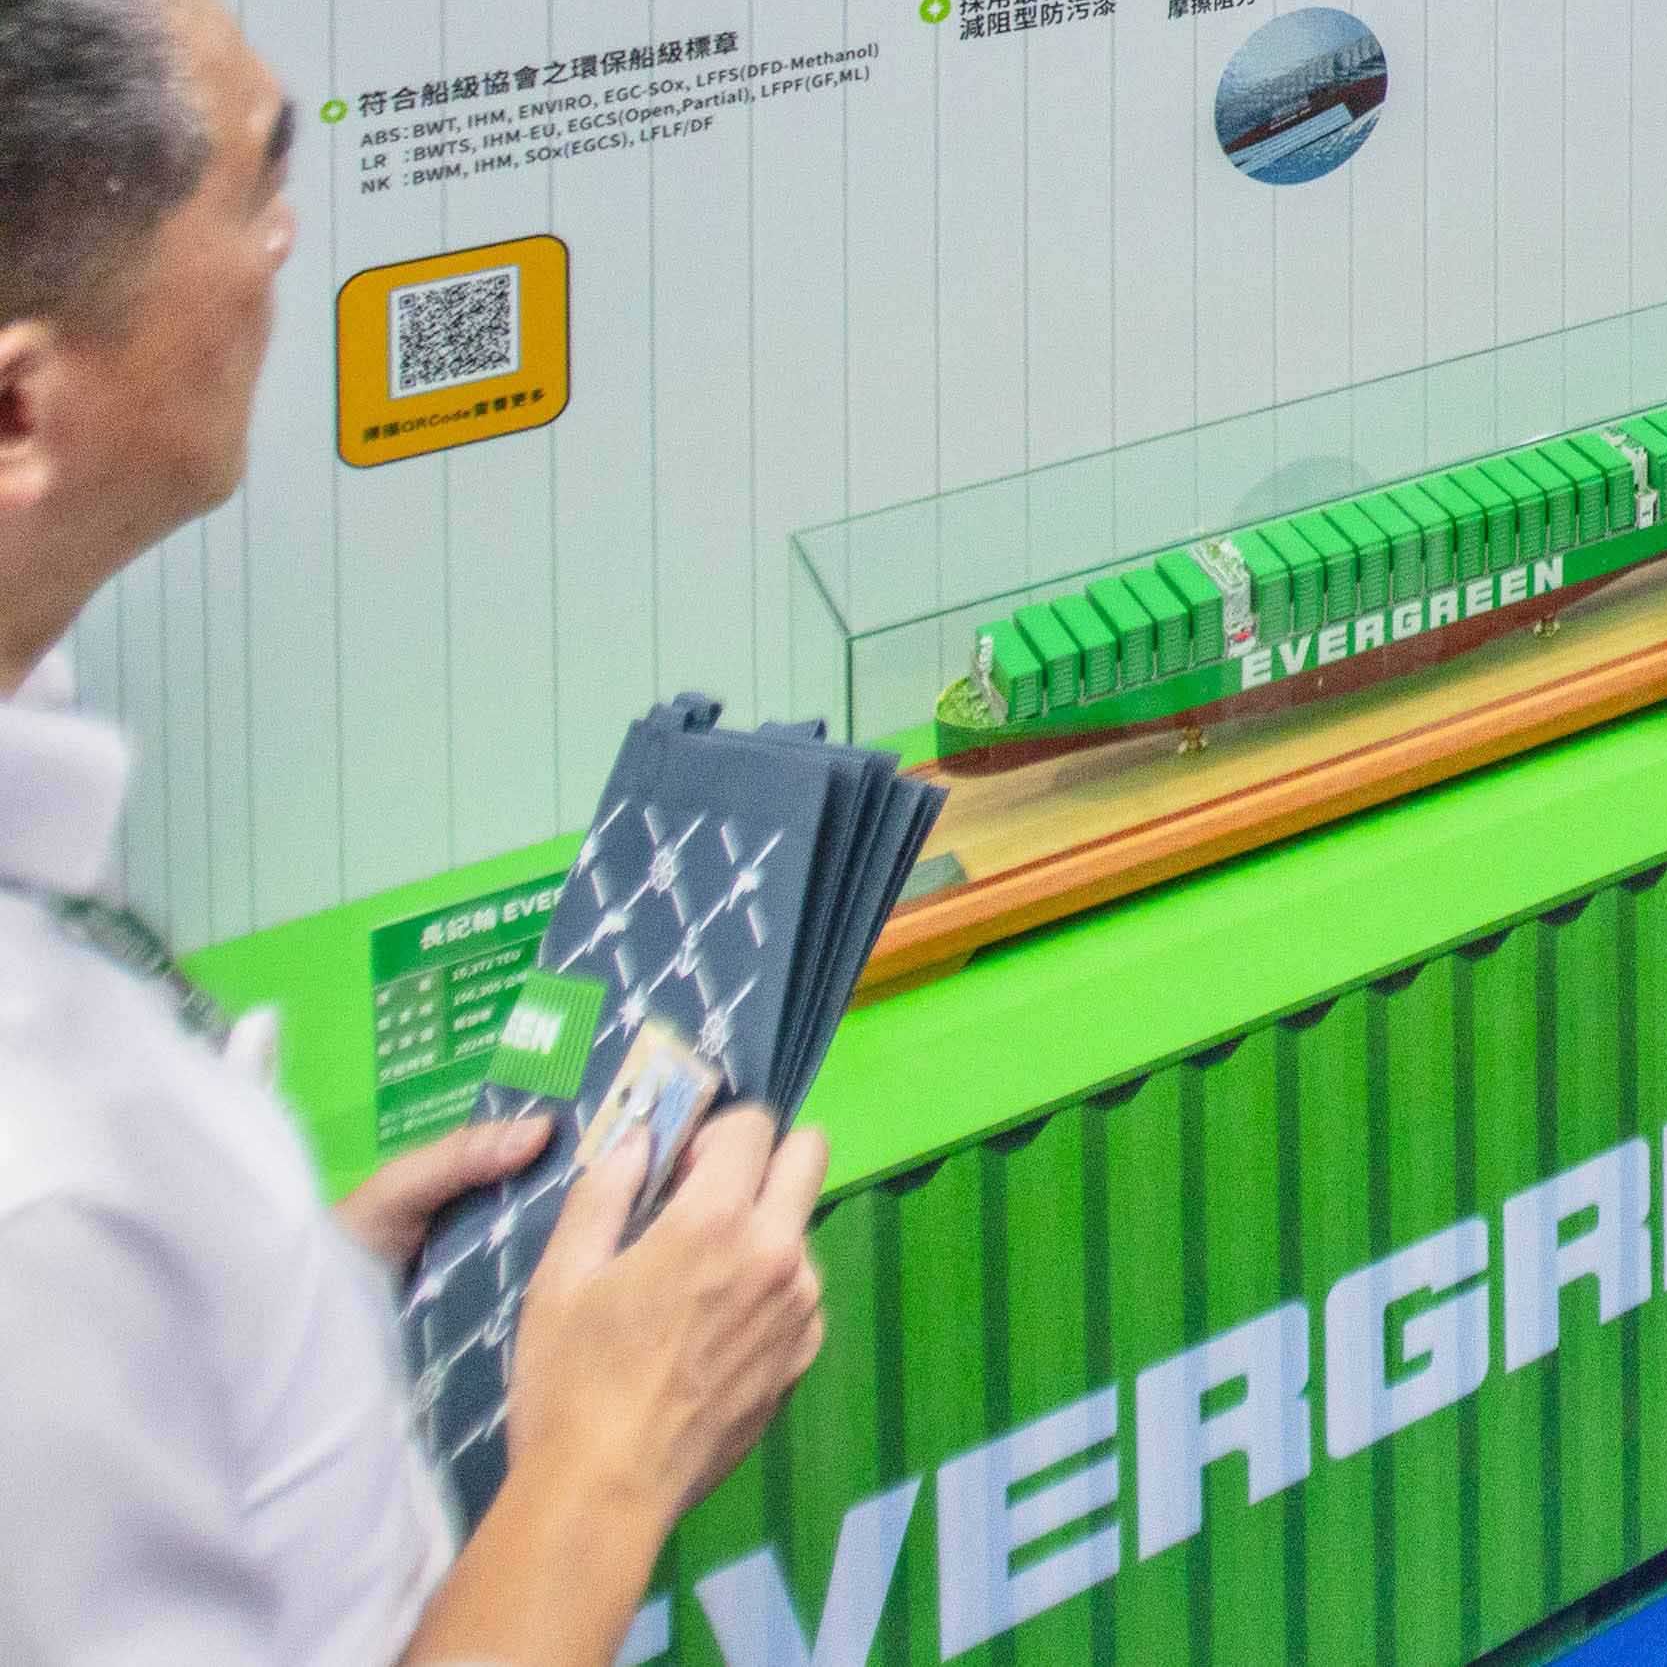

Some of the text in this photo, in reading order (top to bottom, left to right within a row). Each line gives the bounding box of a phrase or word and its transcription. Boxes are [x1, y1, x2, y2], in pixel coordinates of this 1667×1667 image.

[467, 109, 513, 130] IHM,
[518, 92, 599, 120] ENVIRO,
[482, 123, 563, 149] IHM-EU,
[360, 175, 392, 195] NK
[474, 154, 520, 175] IHM,
[639, 115, 715, 143] LFLF/DF
[1241, 556, 1565, 692] EVERGREEN
